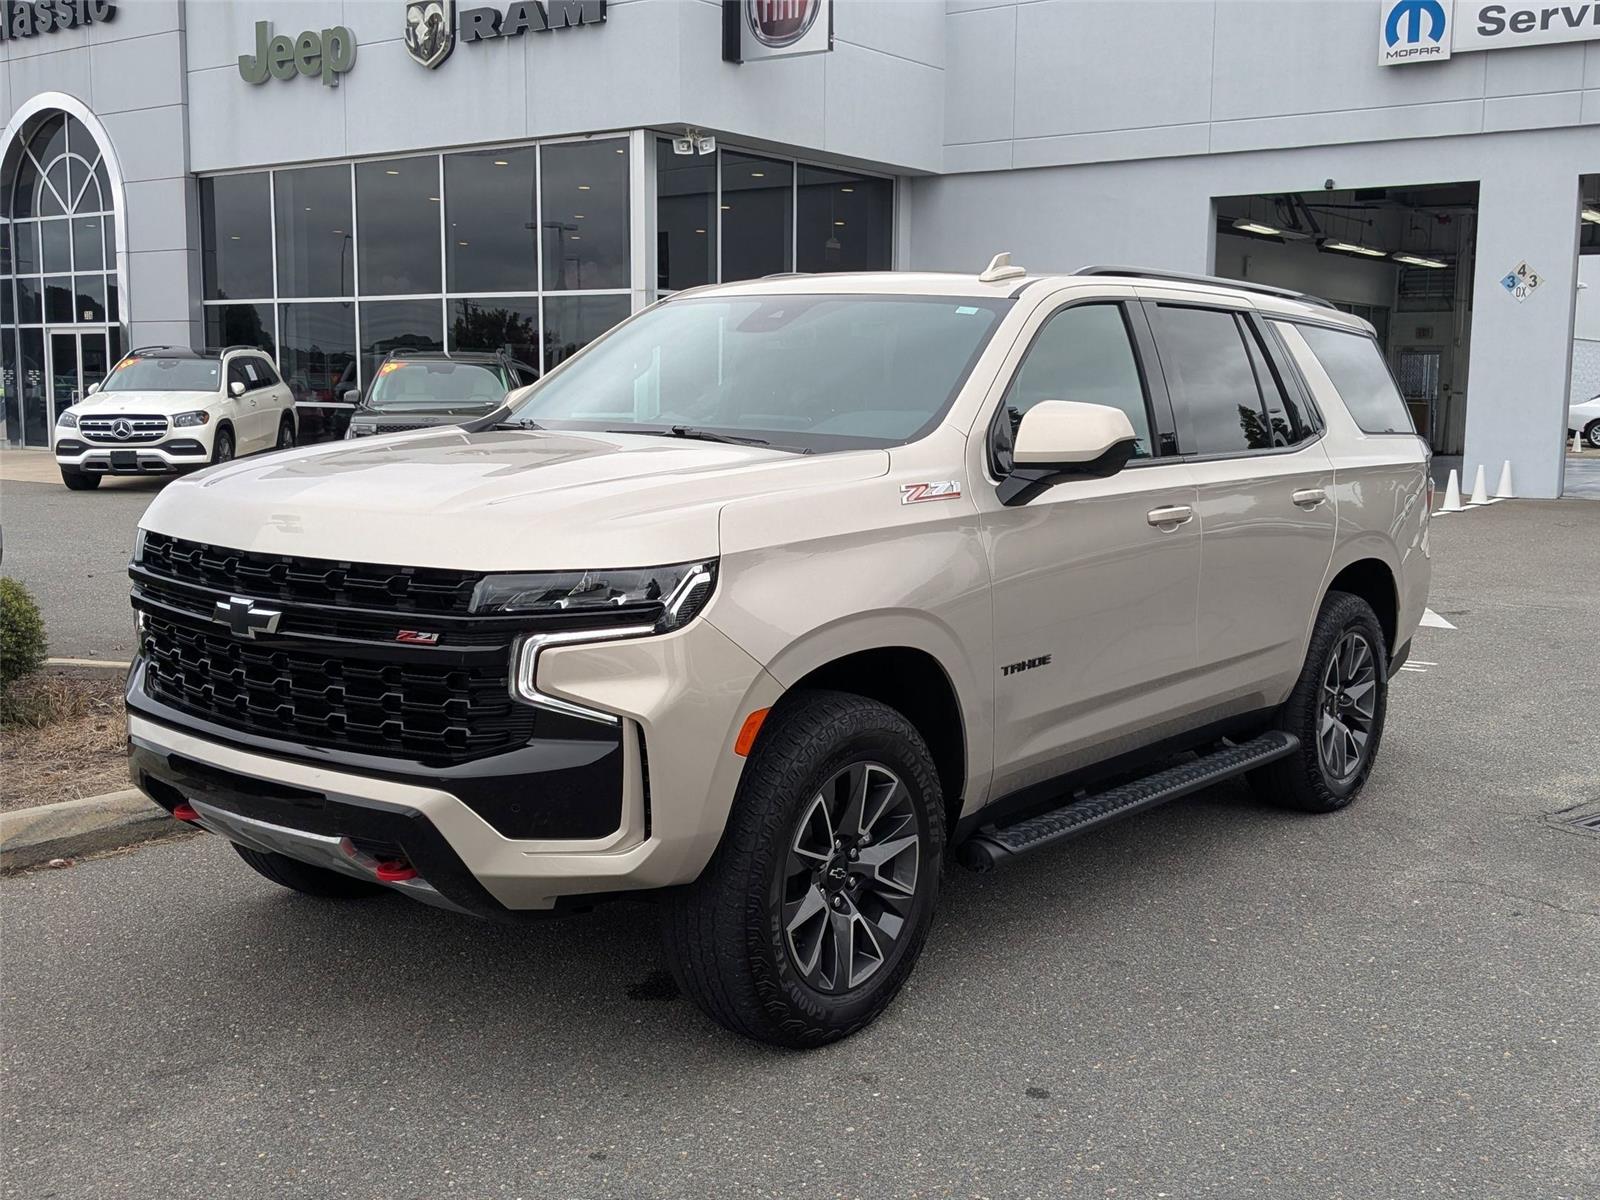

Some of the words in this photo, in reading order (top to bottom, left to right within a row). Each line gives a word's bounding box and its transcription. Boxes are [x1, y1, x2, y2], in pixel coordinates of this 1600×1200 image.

[459, 0, 602, 42] RAM
[238, 21, 354, 87] Jeep
[1386, 46, 1441, 59] MOPAR
[1517, 264, 1527, 277] 4
[1507, 275, 1516, 288] 3
[1528, 275, 1538, 287] 3
[900, 480, 961, 505] Z71
[395, 629, 440, 644] Z71
[1000, 654, 1052, 677] TAHOE
